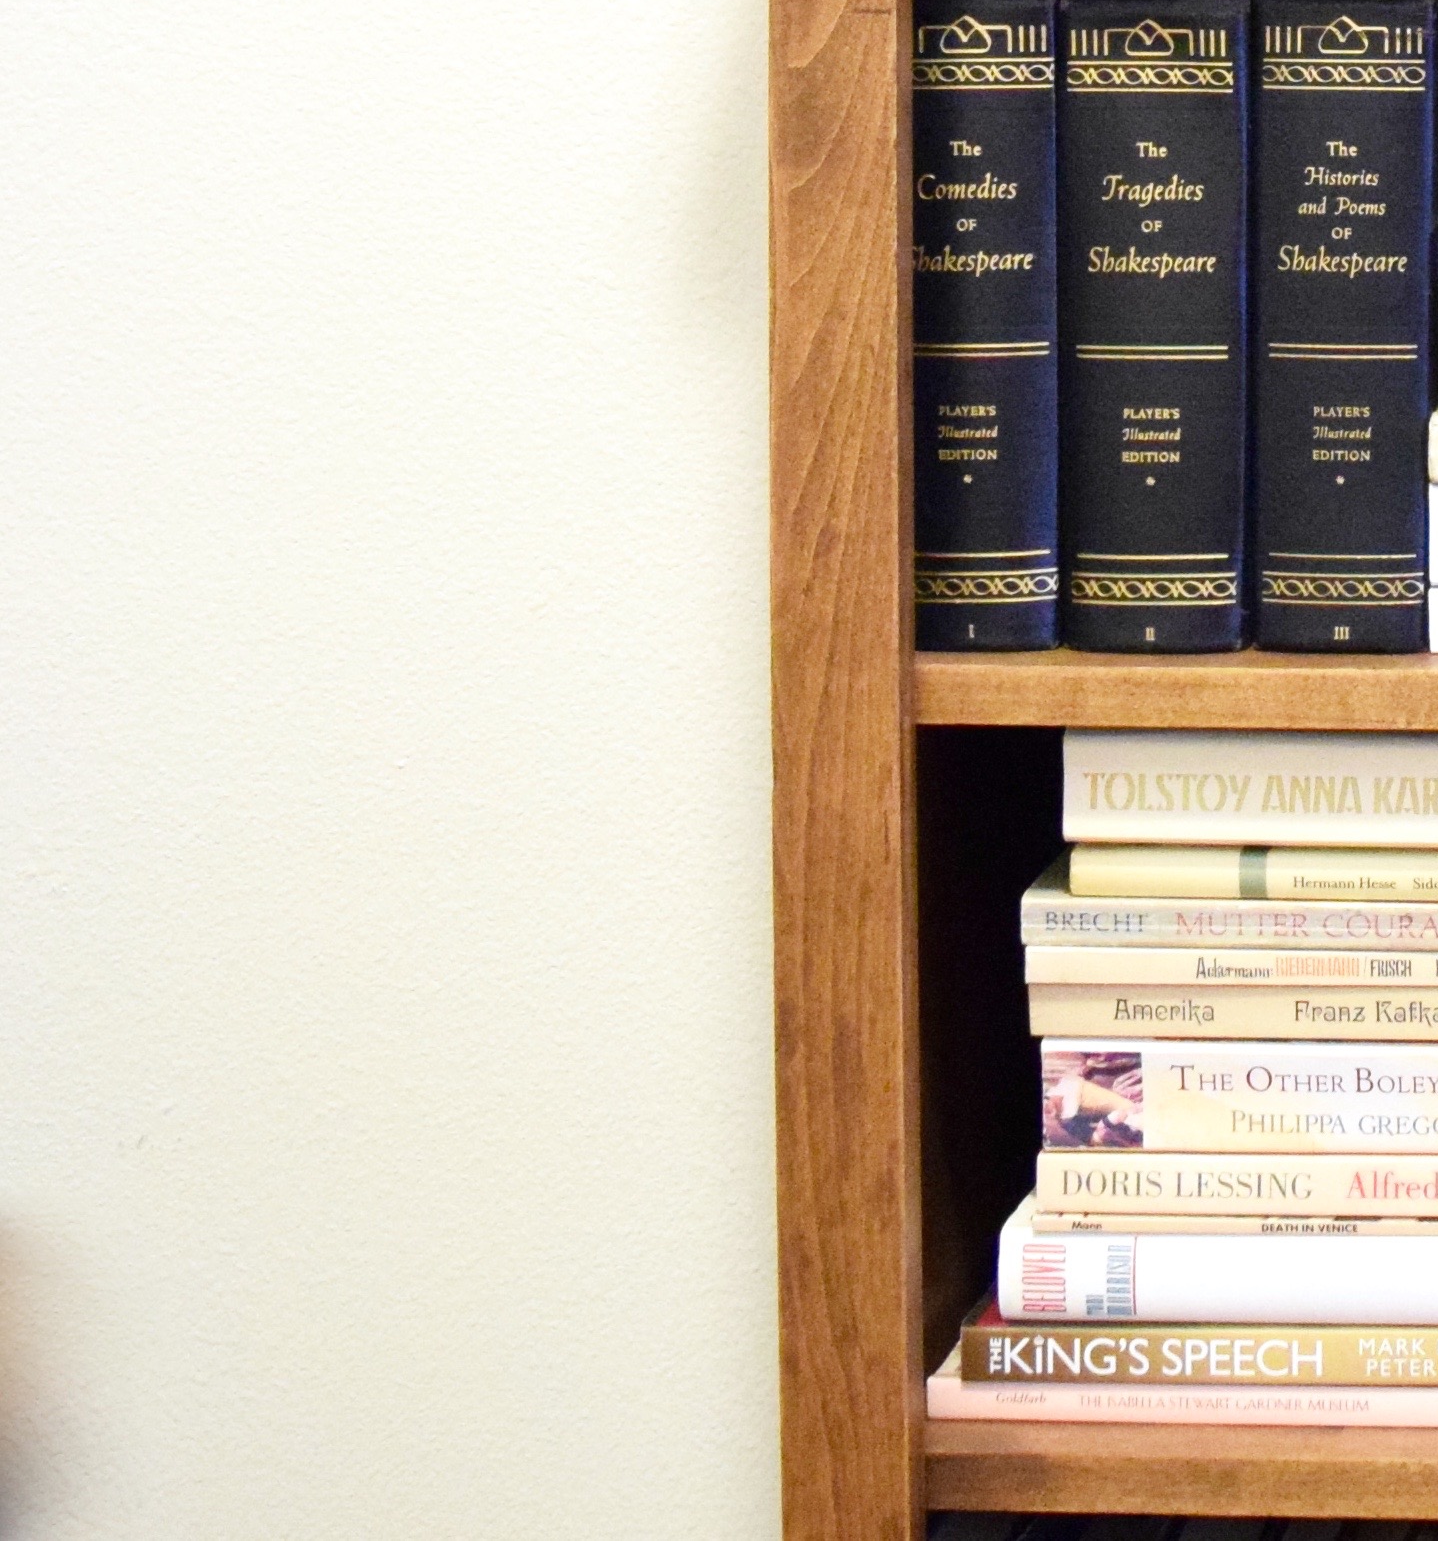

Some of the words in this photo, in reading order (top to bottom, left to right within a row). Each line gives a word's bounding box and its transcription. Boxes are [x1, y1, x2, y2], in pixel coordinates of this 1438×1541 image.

[1136, 141, 1167, 158] The
[1101, 174, 1203, 208] Tragedies
[1141, 220, 1162, 232] OF
[1088, 247, 1216, 278] Shakespeare
[1122, 450, 1180, 463] EDITION
[1293, 877, 1354, 890] Hermann
[1359, 877, 1396, 890] Hesse
[1170, 1064, 1234, 1091] THE
[1245, 1064, 1346, 1093] OTHER
[1261, 1224, 1298, 1233] DEATH
[1302, 1224, 1312, 1233] IN
[1316, 1224, 1358, 1233] VENICE
[989, 1337, 1001, 1373] THE
[1161, 1337, 1324, 1375] SPEECH
